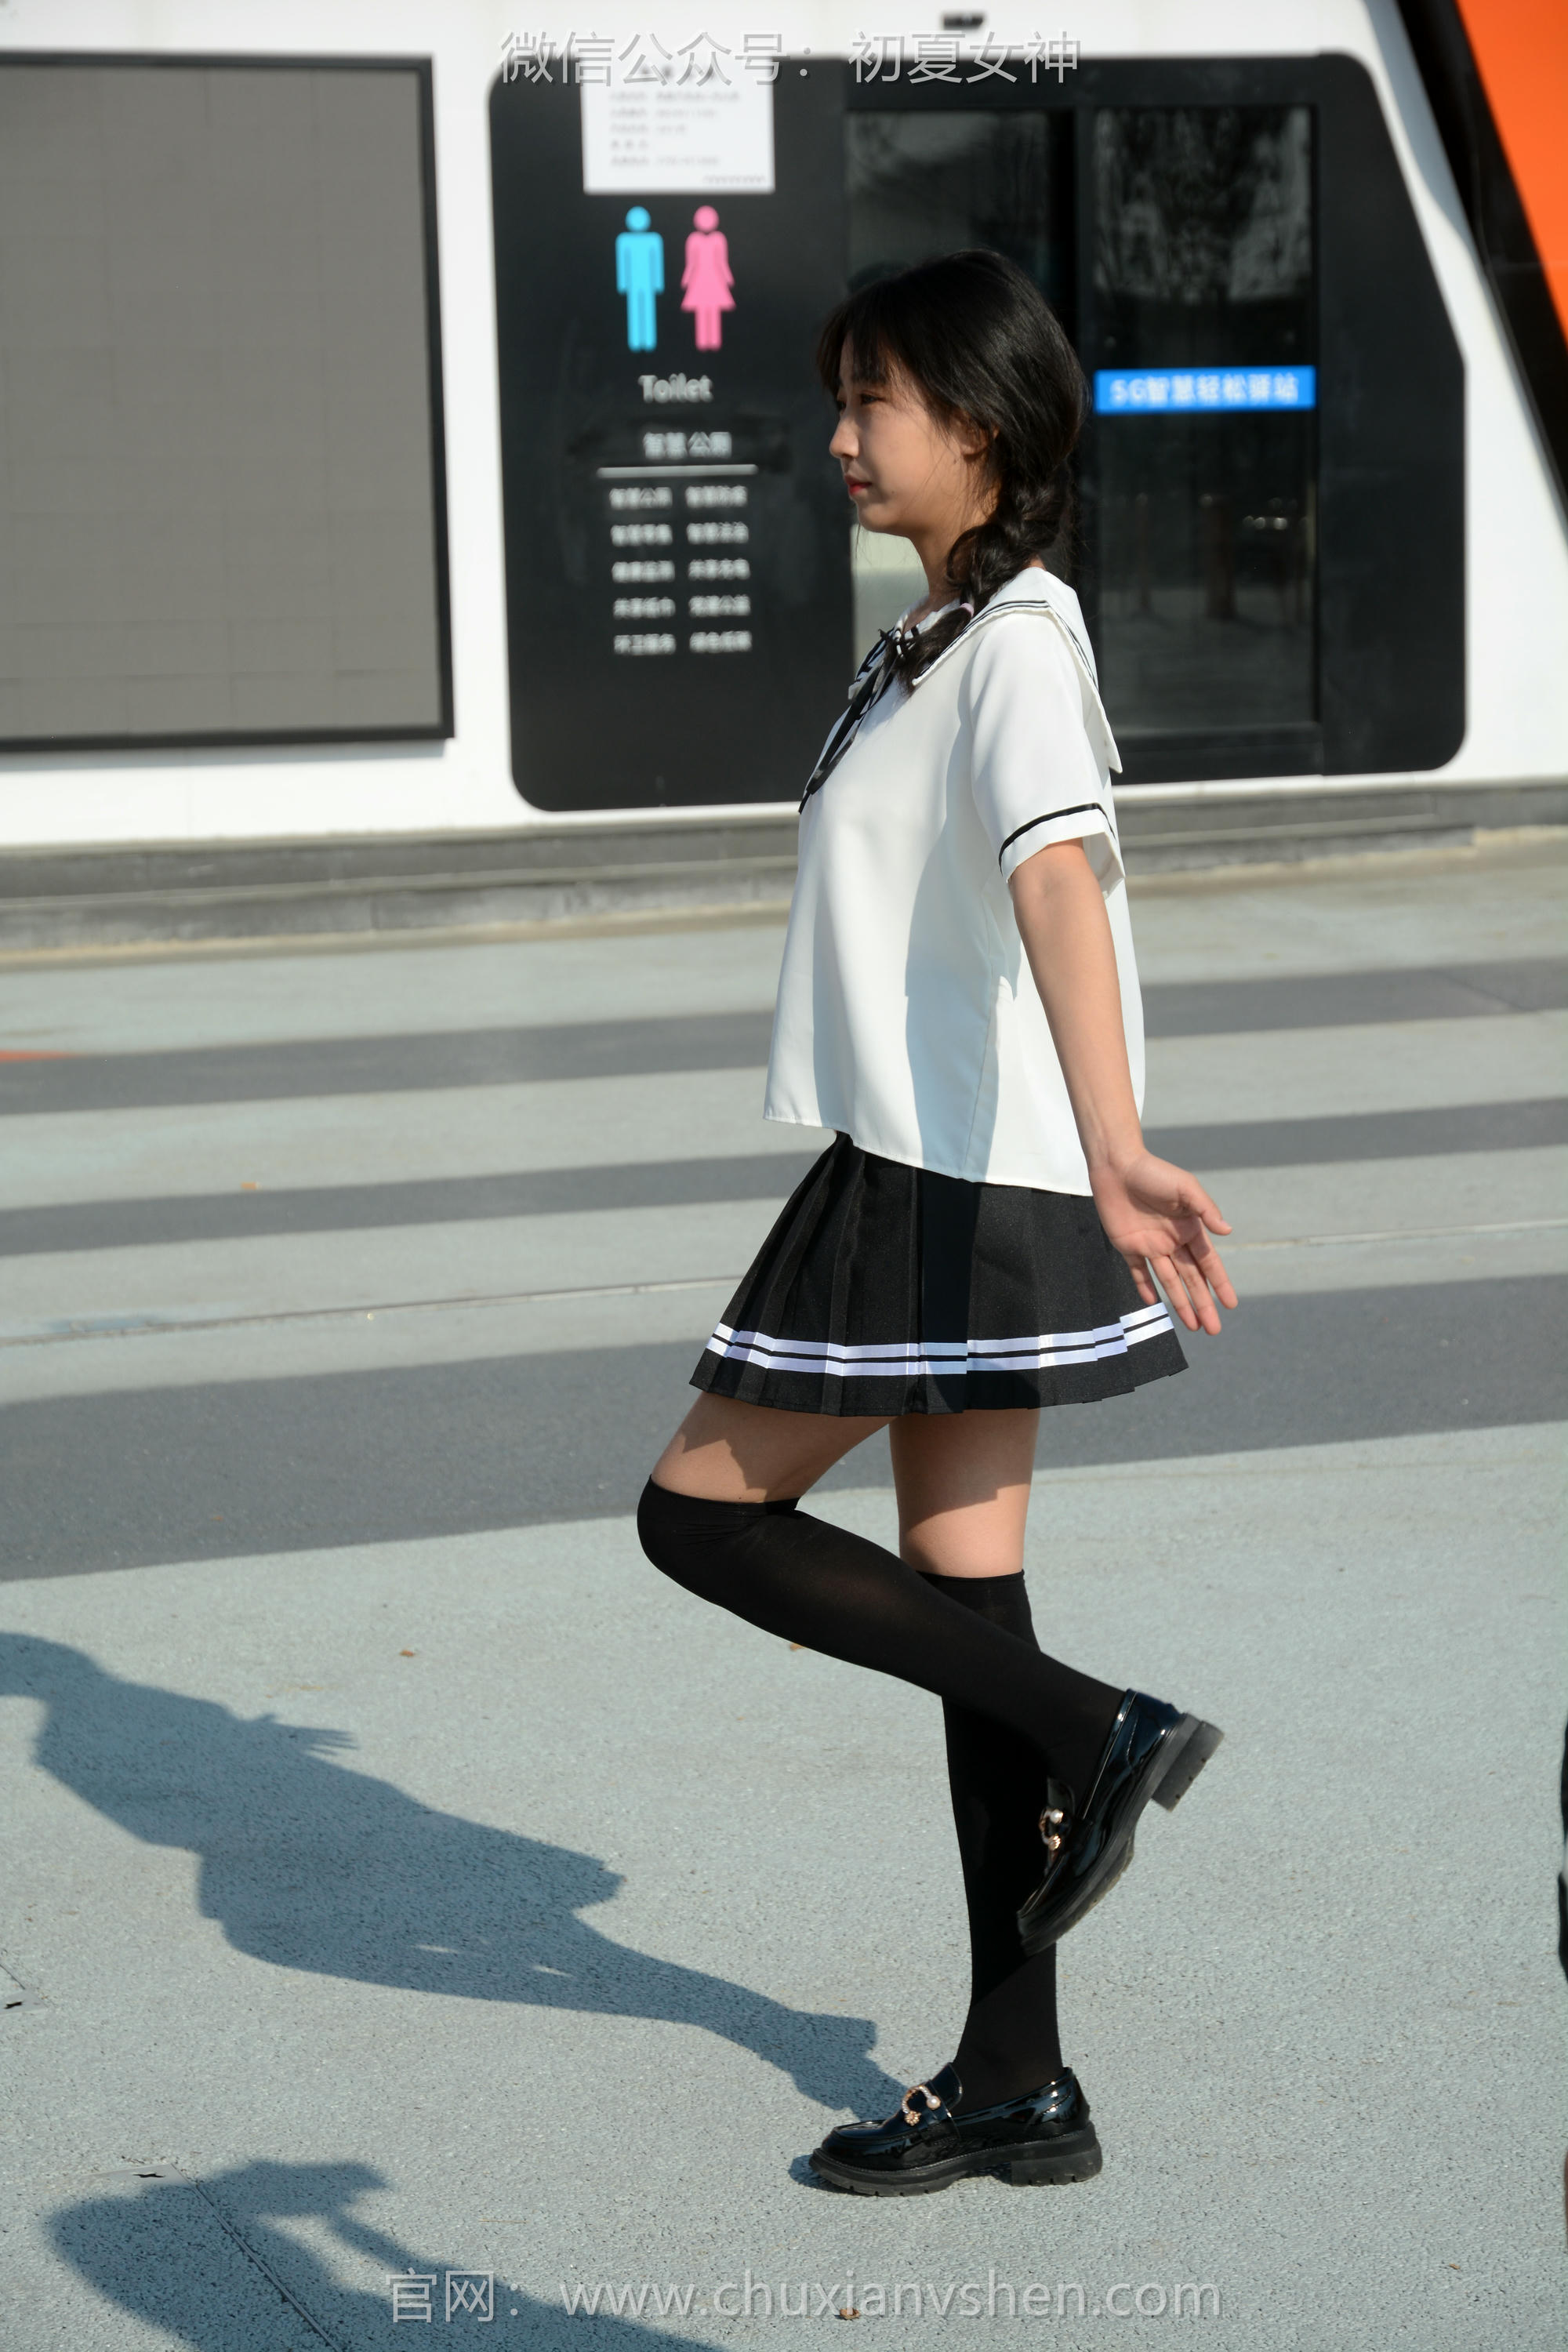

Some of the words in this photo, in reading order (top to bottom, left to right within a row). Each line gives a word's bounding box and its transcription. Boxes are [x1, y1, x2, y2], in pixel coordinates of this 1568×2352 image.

[637, 372, 713, 403] Toilet
[643, 432, 732, 459] 智慧公厕
